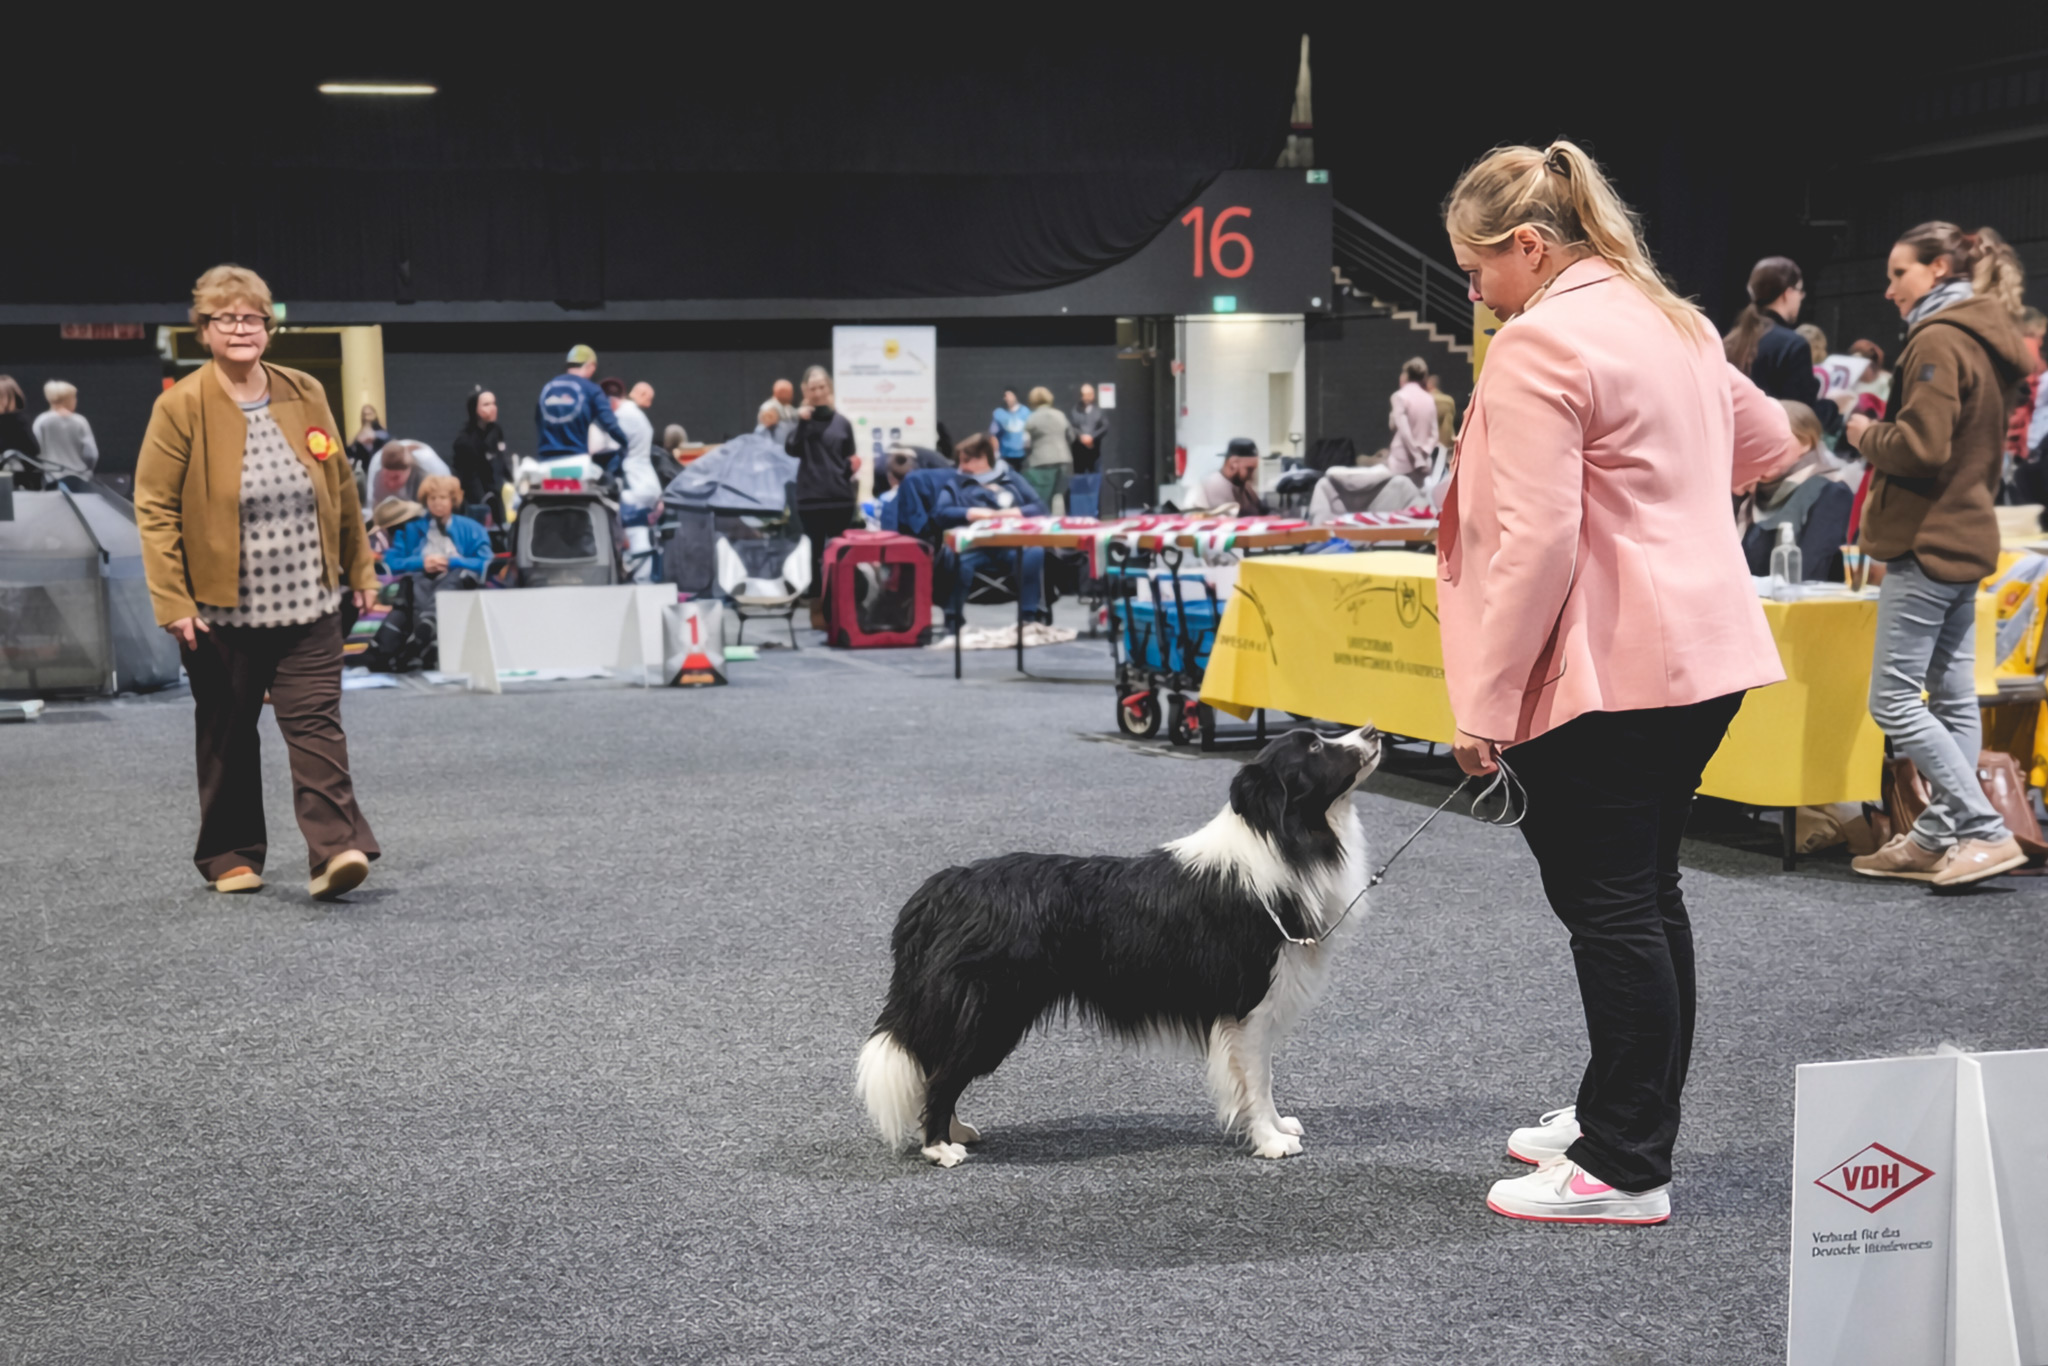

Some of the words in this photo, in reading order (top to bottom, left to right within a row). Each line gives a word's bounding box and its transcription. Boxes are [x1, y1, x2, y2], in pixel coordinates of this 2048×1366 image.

[1181, 205, 1254, 278] 16
[686, 613, 699, 646] 1
[1841, 1163, 1900, 1191] VDH
